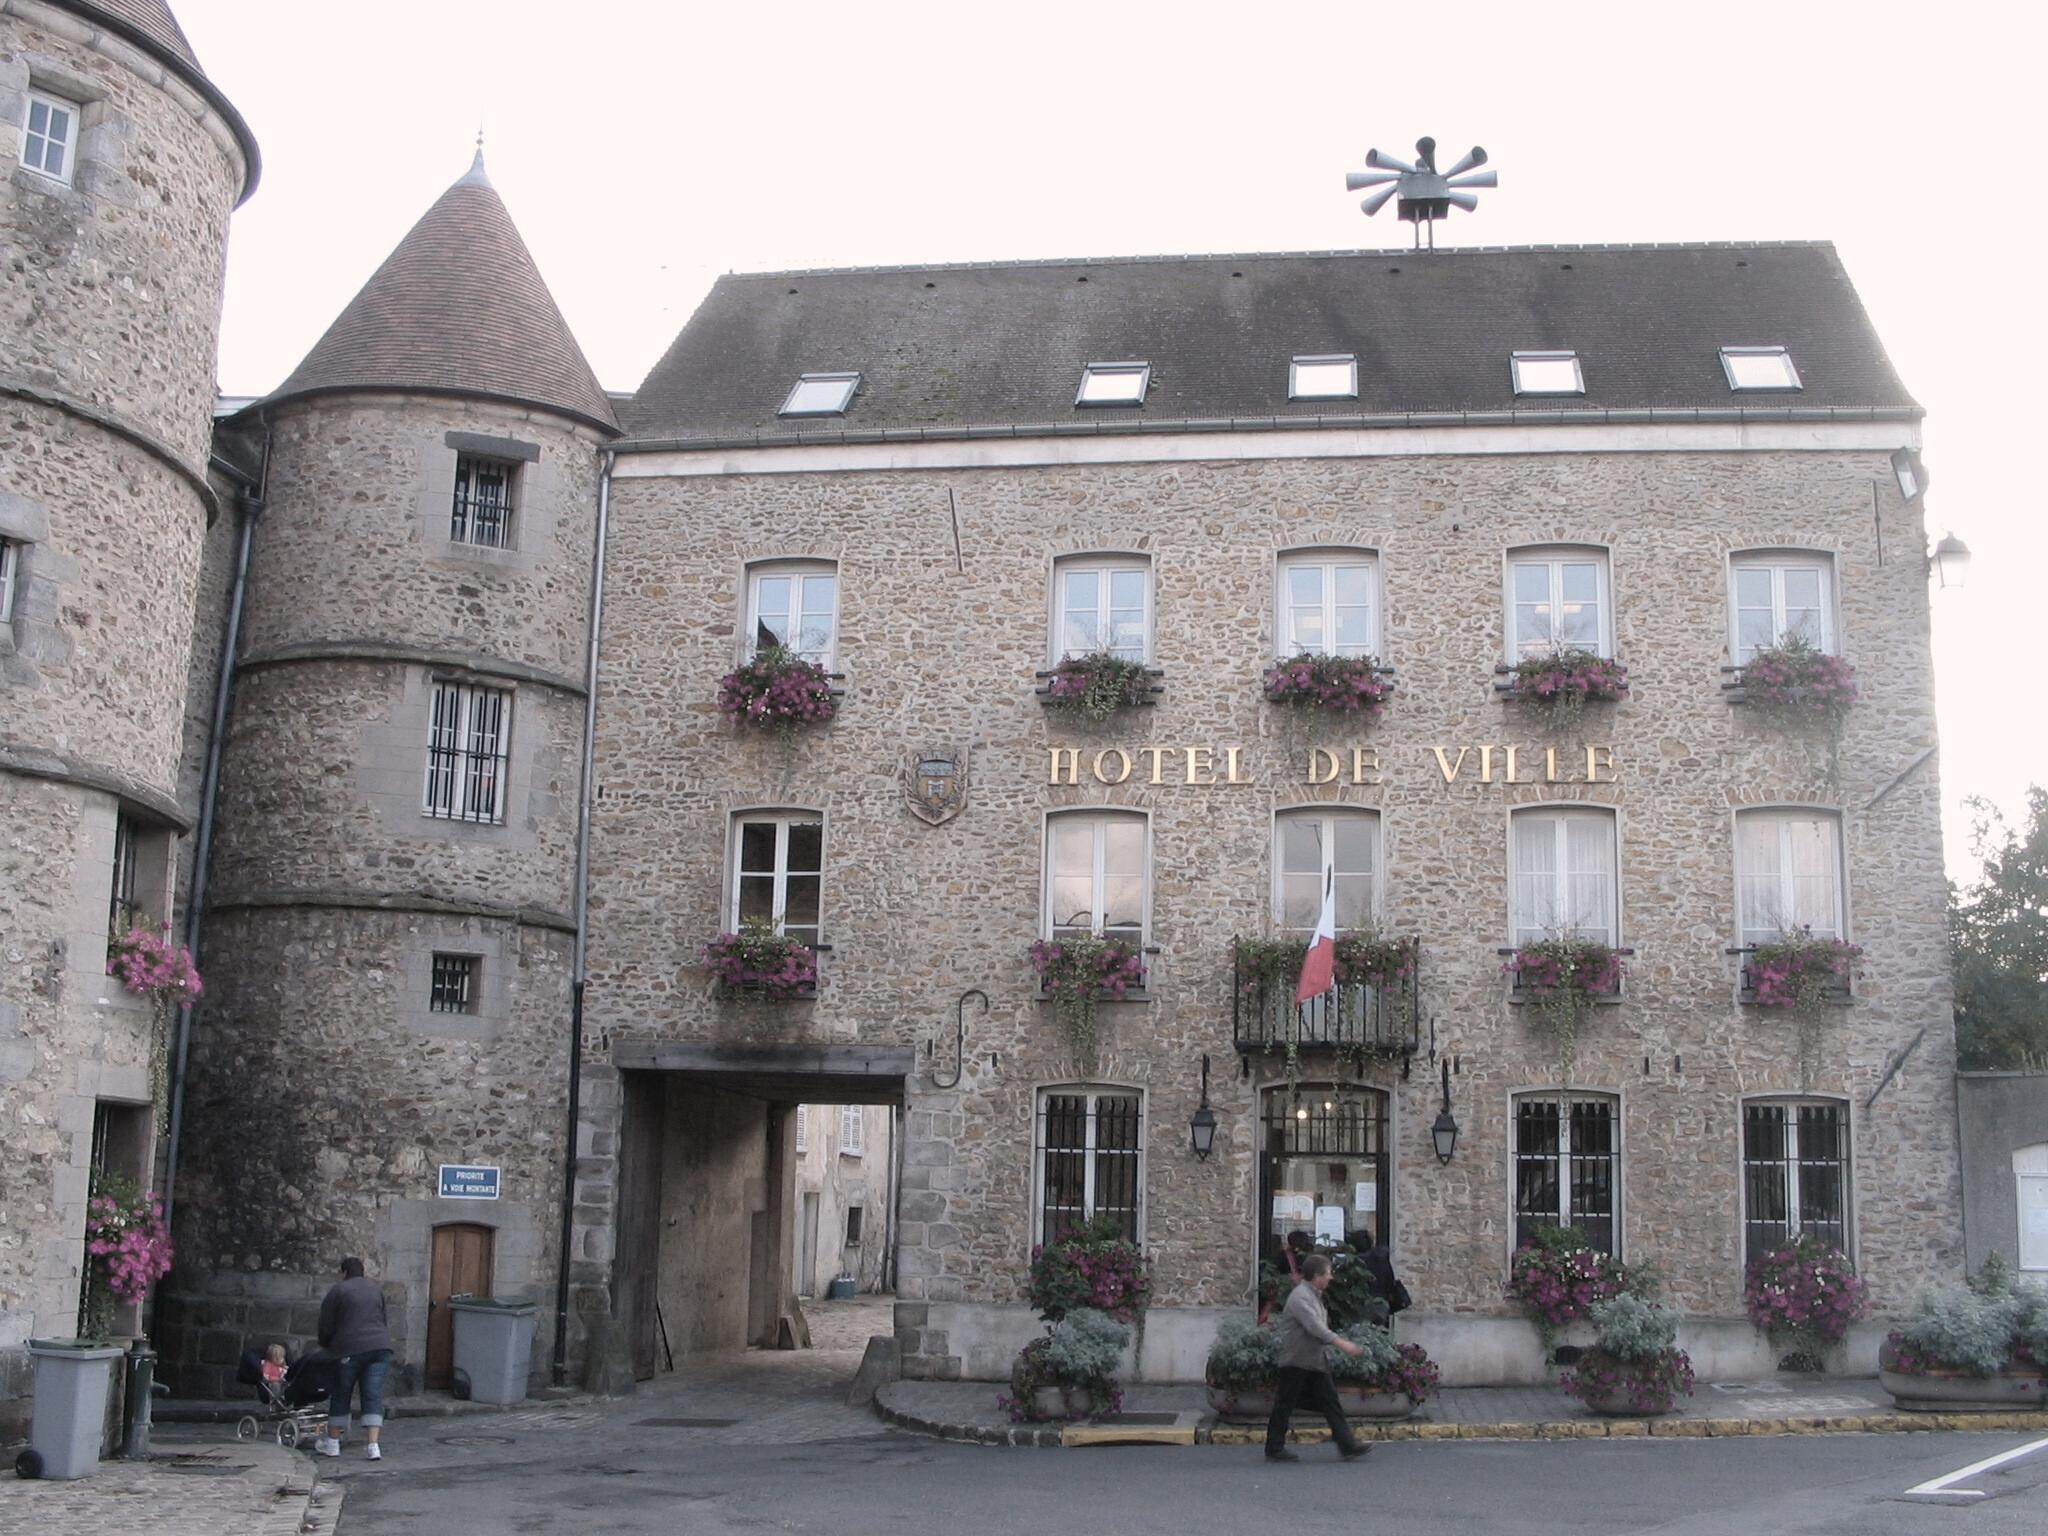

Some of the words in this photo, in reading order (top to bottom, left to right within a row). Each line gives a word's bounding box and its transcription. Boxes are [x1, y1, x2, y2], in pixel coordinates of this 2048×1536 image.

[1047, 746, 1256, 786] HOTEL
[1303, 745, 1384, 785] DE
[1431, 744, 1619, 784] VILLE
[443, 1183, 448, 1191] A
